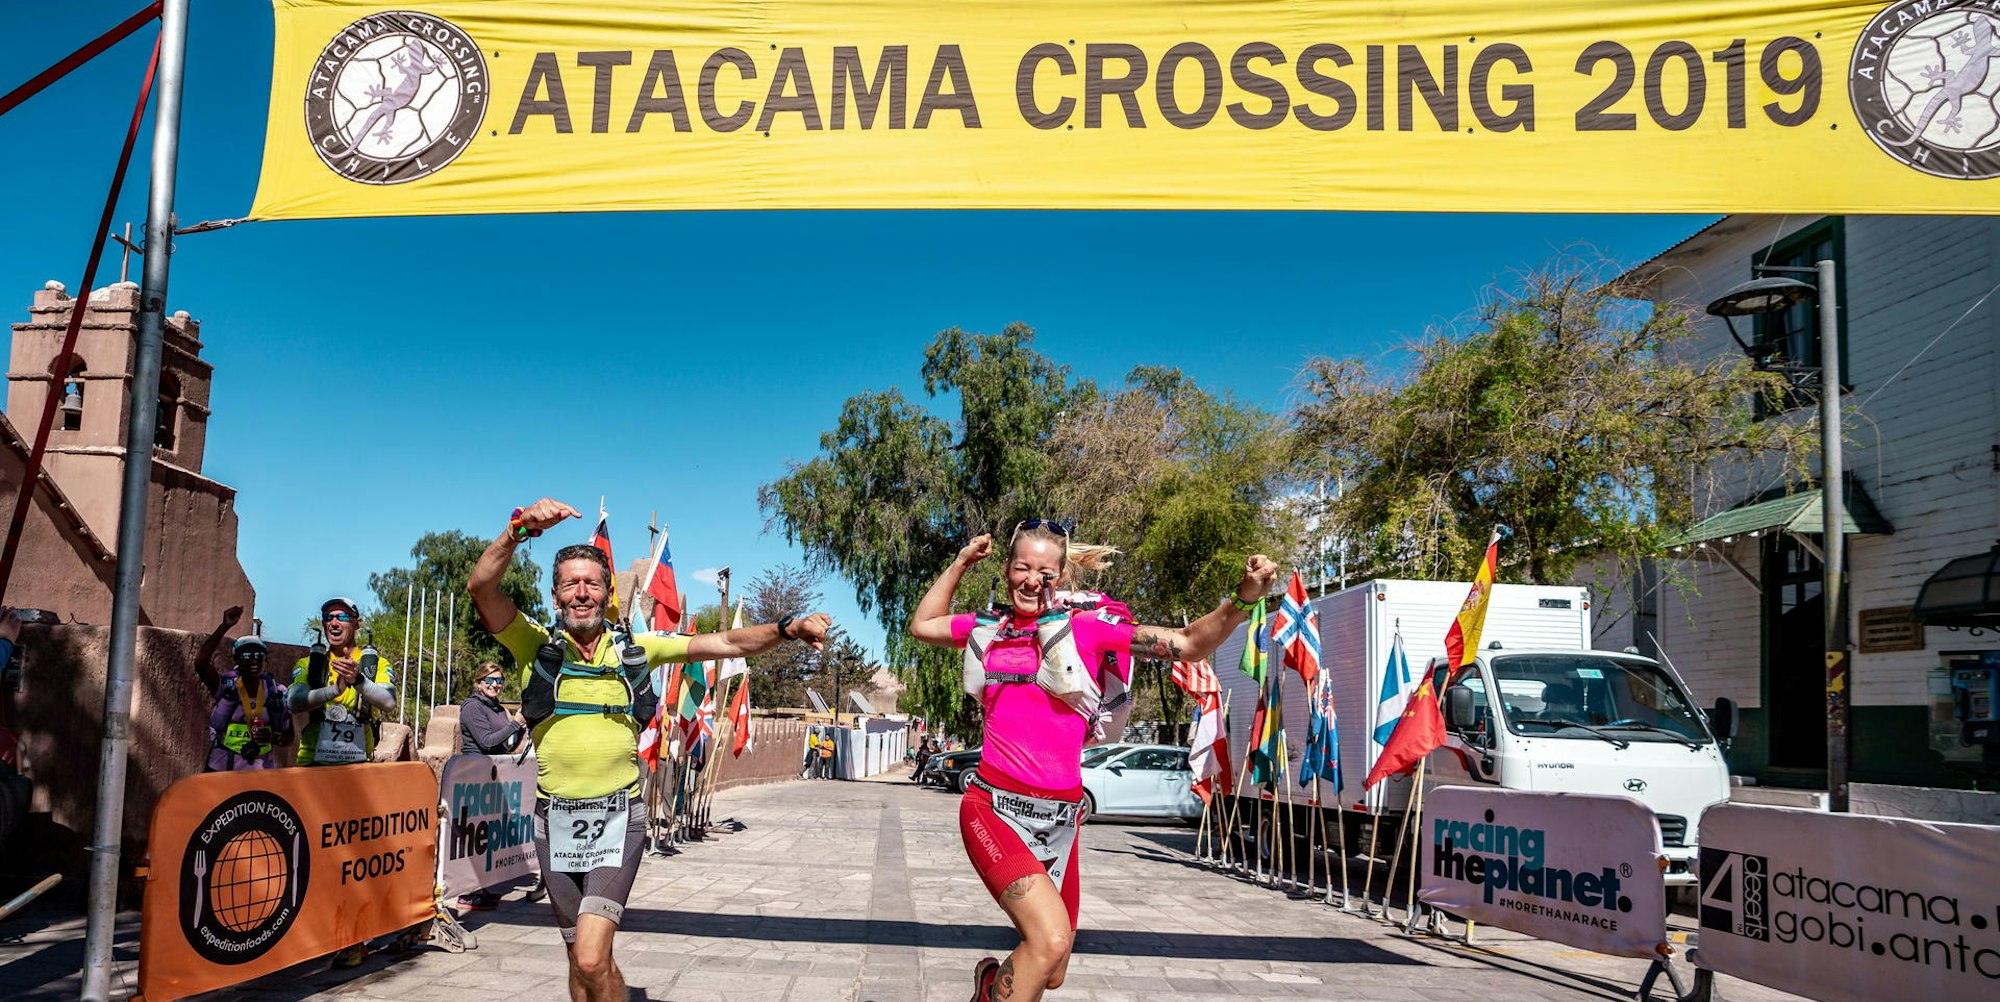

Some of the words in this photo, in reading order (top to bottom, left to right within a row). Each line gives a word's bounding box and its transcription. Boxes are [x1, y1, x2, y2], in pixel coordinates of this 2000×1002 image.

[312, 19, 387, 99] ATACAMA
[508, 44, 983, 135] ATACAMA
[1015, 41, 1535, 133] CROSSING
[1574, 36, 1823, 132] 2019
[322, 132, 462, 178] CHILE
[331, 730, 355, 743] 79
[201, 802, 266, 845] EXPEDITION
[266, 803, 296, 836] FOODS
[321, 808, 429, 849] EXPEDITION
[572, 819, 606, 843] 23
[1434, 808, 1545, 870] racing
[1499, 897, 1619, 932] #MORETHANARACE
[1701, 853, 1744, 936] 4
[1744, 856, 1768, 940] deserts
[201, 907, 290, 952] expeditionfoods.com
